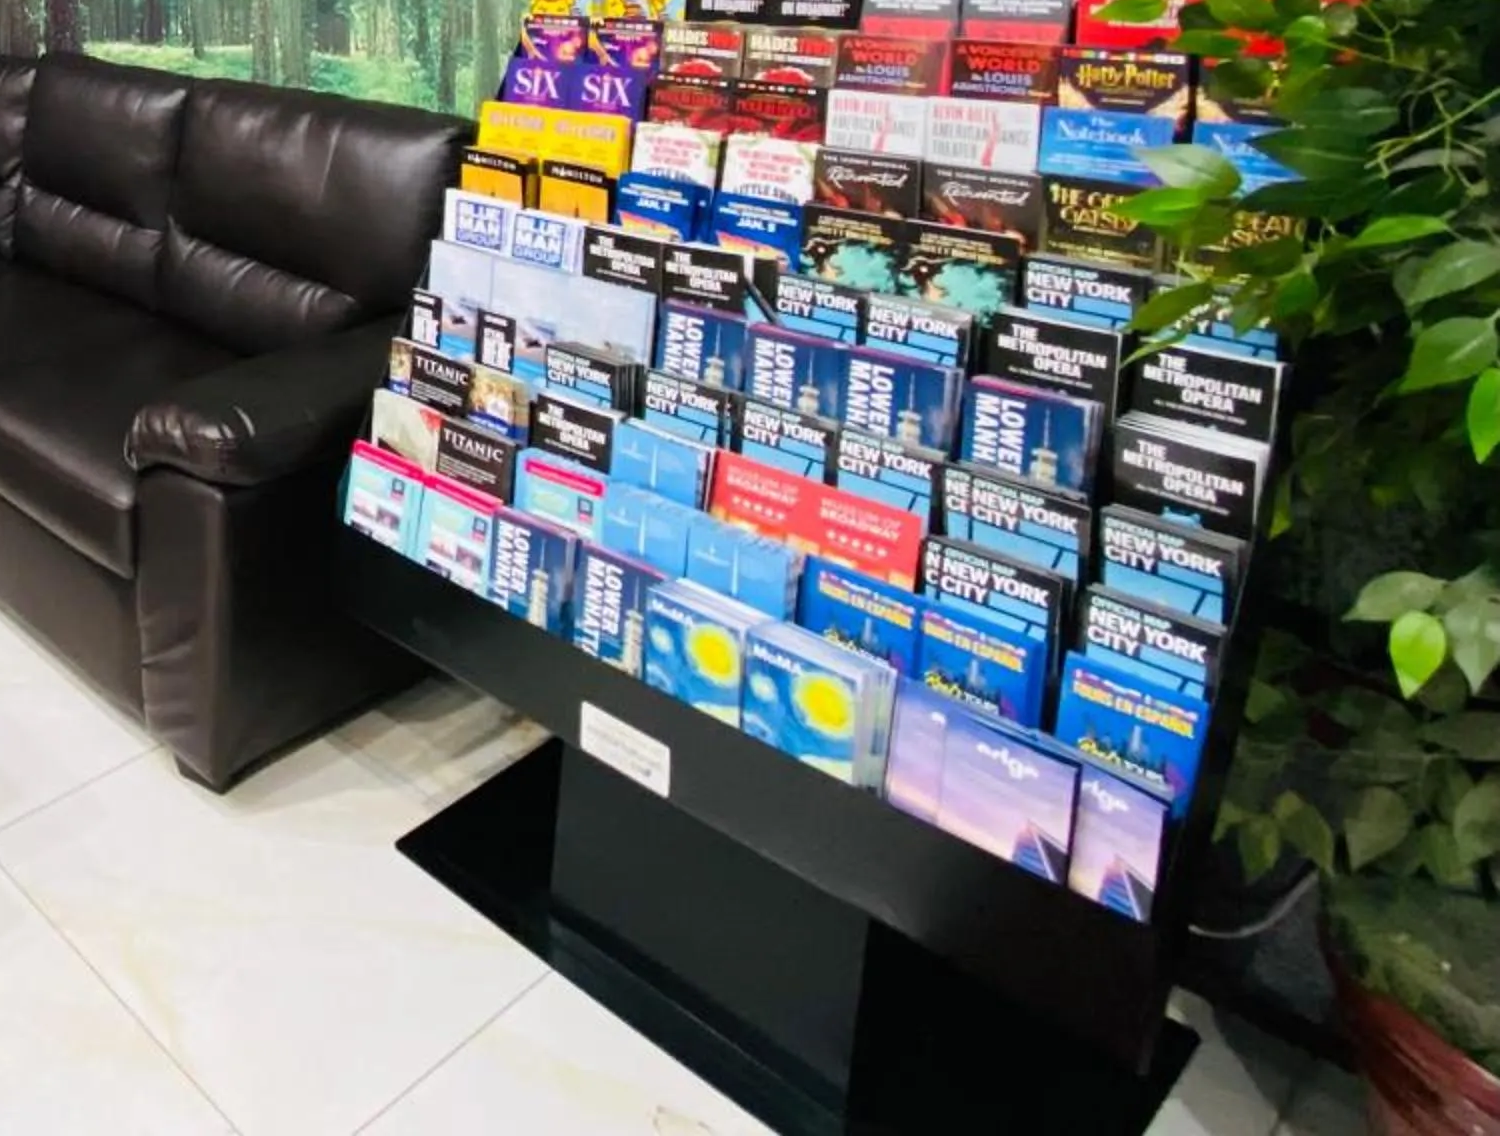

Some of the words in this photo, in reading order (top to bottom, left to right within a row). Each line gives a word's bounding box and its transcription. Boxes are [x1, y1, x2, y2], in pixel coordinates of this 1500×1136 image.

[967, 56, 1041, 74] WORLD
[1077, 64, 1124, 90] Harry
[1125, 63, 1176, 89] Potter
[983, 73, 1033, 86] LOUIS
[1058, 119, 1147, 146] Notebook
[459, 215, 500, 234] MAN
[517, 216, 564, 234] BLUE
[516, 230, 561, 251] MAN
[665, 260, 738, 284] METROPOLITAN
[673, 251, 692, 265] THE
[689, 276, 723, 293] OPERA
[778, 283, 812, 304] NEW
[814, 292, 858, 314] YORK
[1027, 271, 1073, 293] NEW
[1075, 279, 1132, 305] YORK
[1027, 286, 1073, 309] CITY
[776, 297, 811, 318] CITY
[868, 321, 909, 343] CITY
[869, 305, 910, 326] NEW
[911, 315, 960, 339] YORK
[1011, 323, 1038, 340] THE
[998, 333, 1107, 370] METROPOLITAN
[1158, 353, 1187, 373] THE
[415, 355, 470, 386] TITANIC
[547, 369, 576, 387] CITY
[548, 357, 575, 375] NEW
[576, 365, 612, 387] YORK
[1033, 356, 1082, 380] OPERA
[647, 380, 679, 400] NEW
[680, 391, 719, 413] YORK
[1143, 364, 1263, 405] METROPOLITAN
[646, 394, 678, 415] CITY
[1180, 388, 1235, 413] OPERA
[743, 426, 780, 448] CITY
[744, 410, 781, 430] NEW
[782, 421, 827, 447] YORK
[443, 428, 504, 463] TITANIC
[840, 438, 881, 463] NEW
[882, 451, 932, 480] YORK
[1136, 439, 1168, 461] THE
[838, 455, 881, 480] CITY
[1122, 449, 1244, 497] METROPOLITAN
[945, 478, 970, 494] NE
[1161, 475, 1218, 505] OPERA
[971, 504, 1018, 532] CITY
[972, 487, 1020, 515] NEW
[1021, 504, 1078, 535] YORK
[509, 525, 532, 594] LOWER
[1104, 527, 1156, 556] NEW
[1159, 545, 1223, 577] YORK
[1104, 544, 1155, 572] CITY
[940, 575, 988, 604] CITY
[943, 557, 990, 586] NEW
[992, 573, 1049, 608] YORK
[602, 563, 625, 635] LOWER
[1087, 624, 1139, 657] CITY
[1088, 605, 1141, 638] NEW
[1143, 625, 1208, 664] YORK
[976, 742, 1040, 780] edge
[1082, 780, 1130, 812] dge
